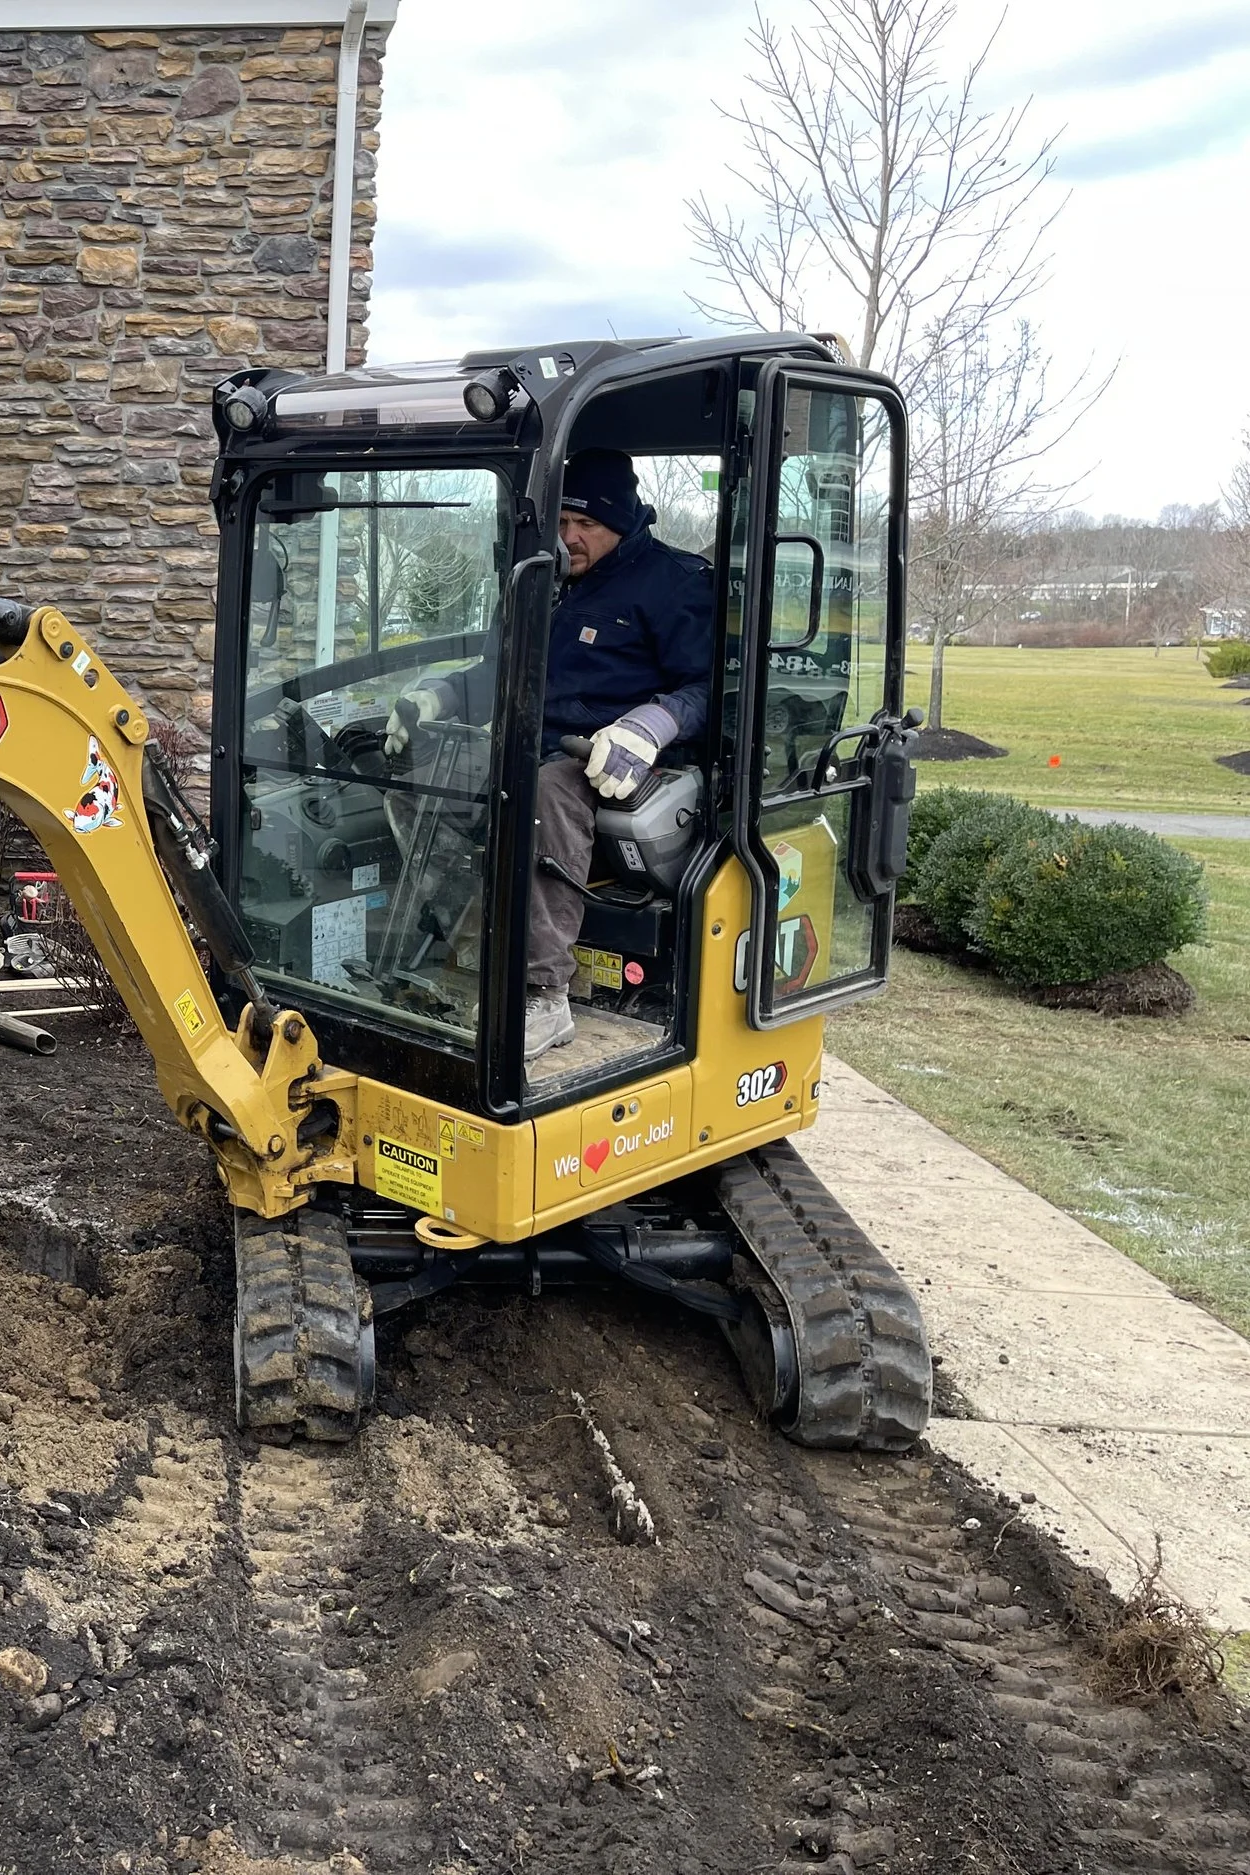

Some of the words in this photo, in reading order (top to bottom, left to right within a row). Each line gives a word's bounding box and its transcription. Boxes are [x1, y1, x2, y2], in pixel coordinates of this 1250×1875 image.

[734, 918, 801, 992] CT
[736, 1064, 777, 1107] 302
[382, 1143, 434, 1173] CAUTION
[553, 1157, 580, 1179] We
[613, 1134, 640, 1156] Our
[644, 1116, 675, 1144] Job!
